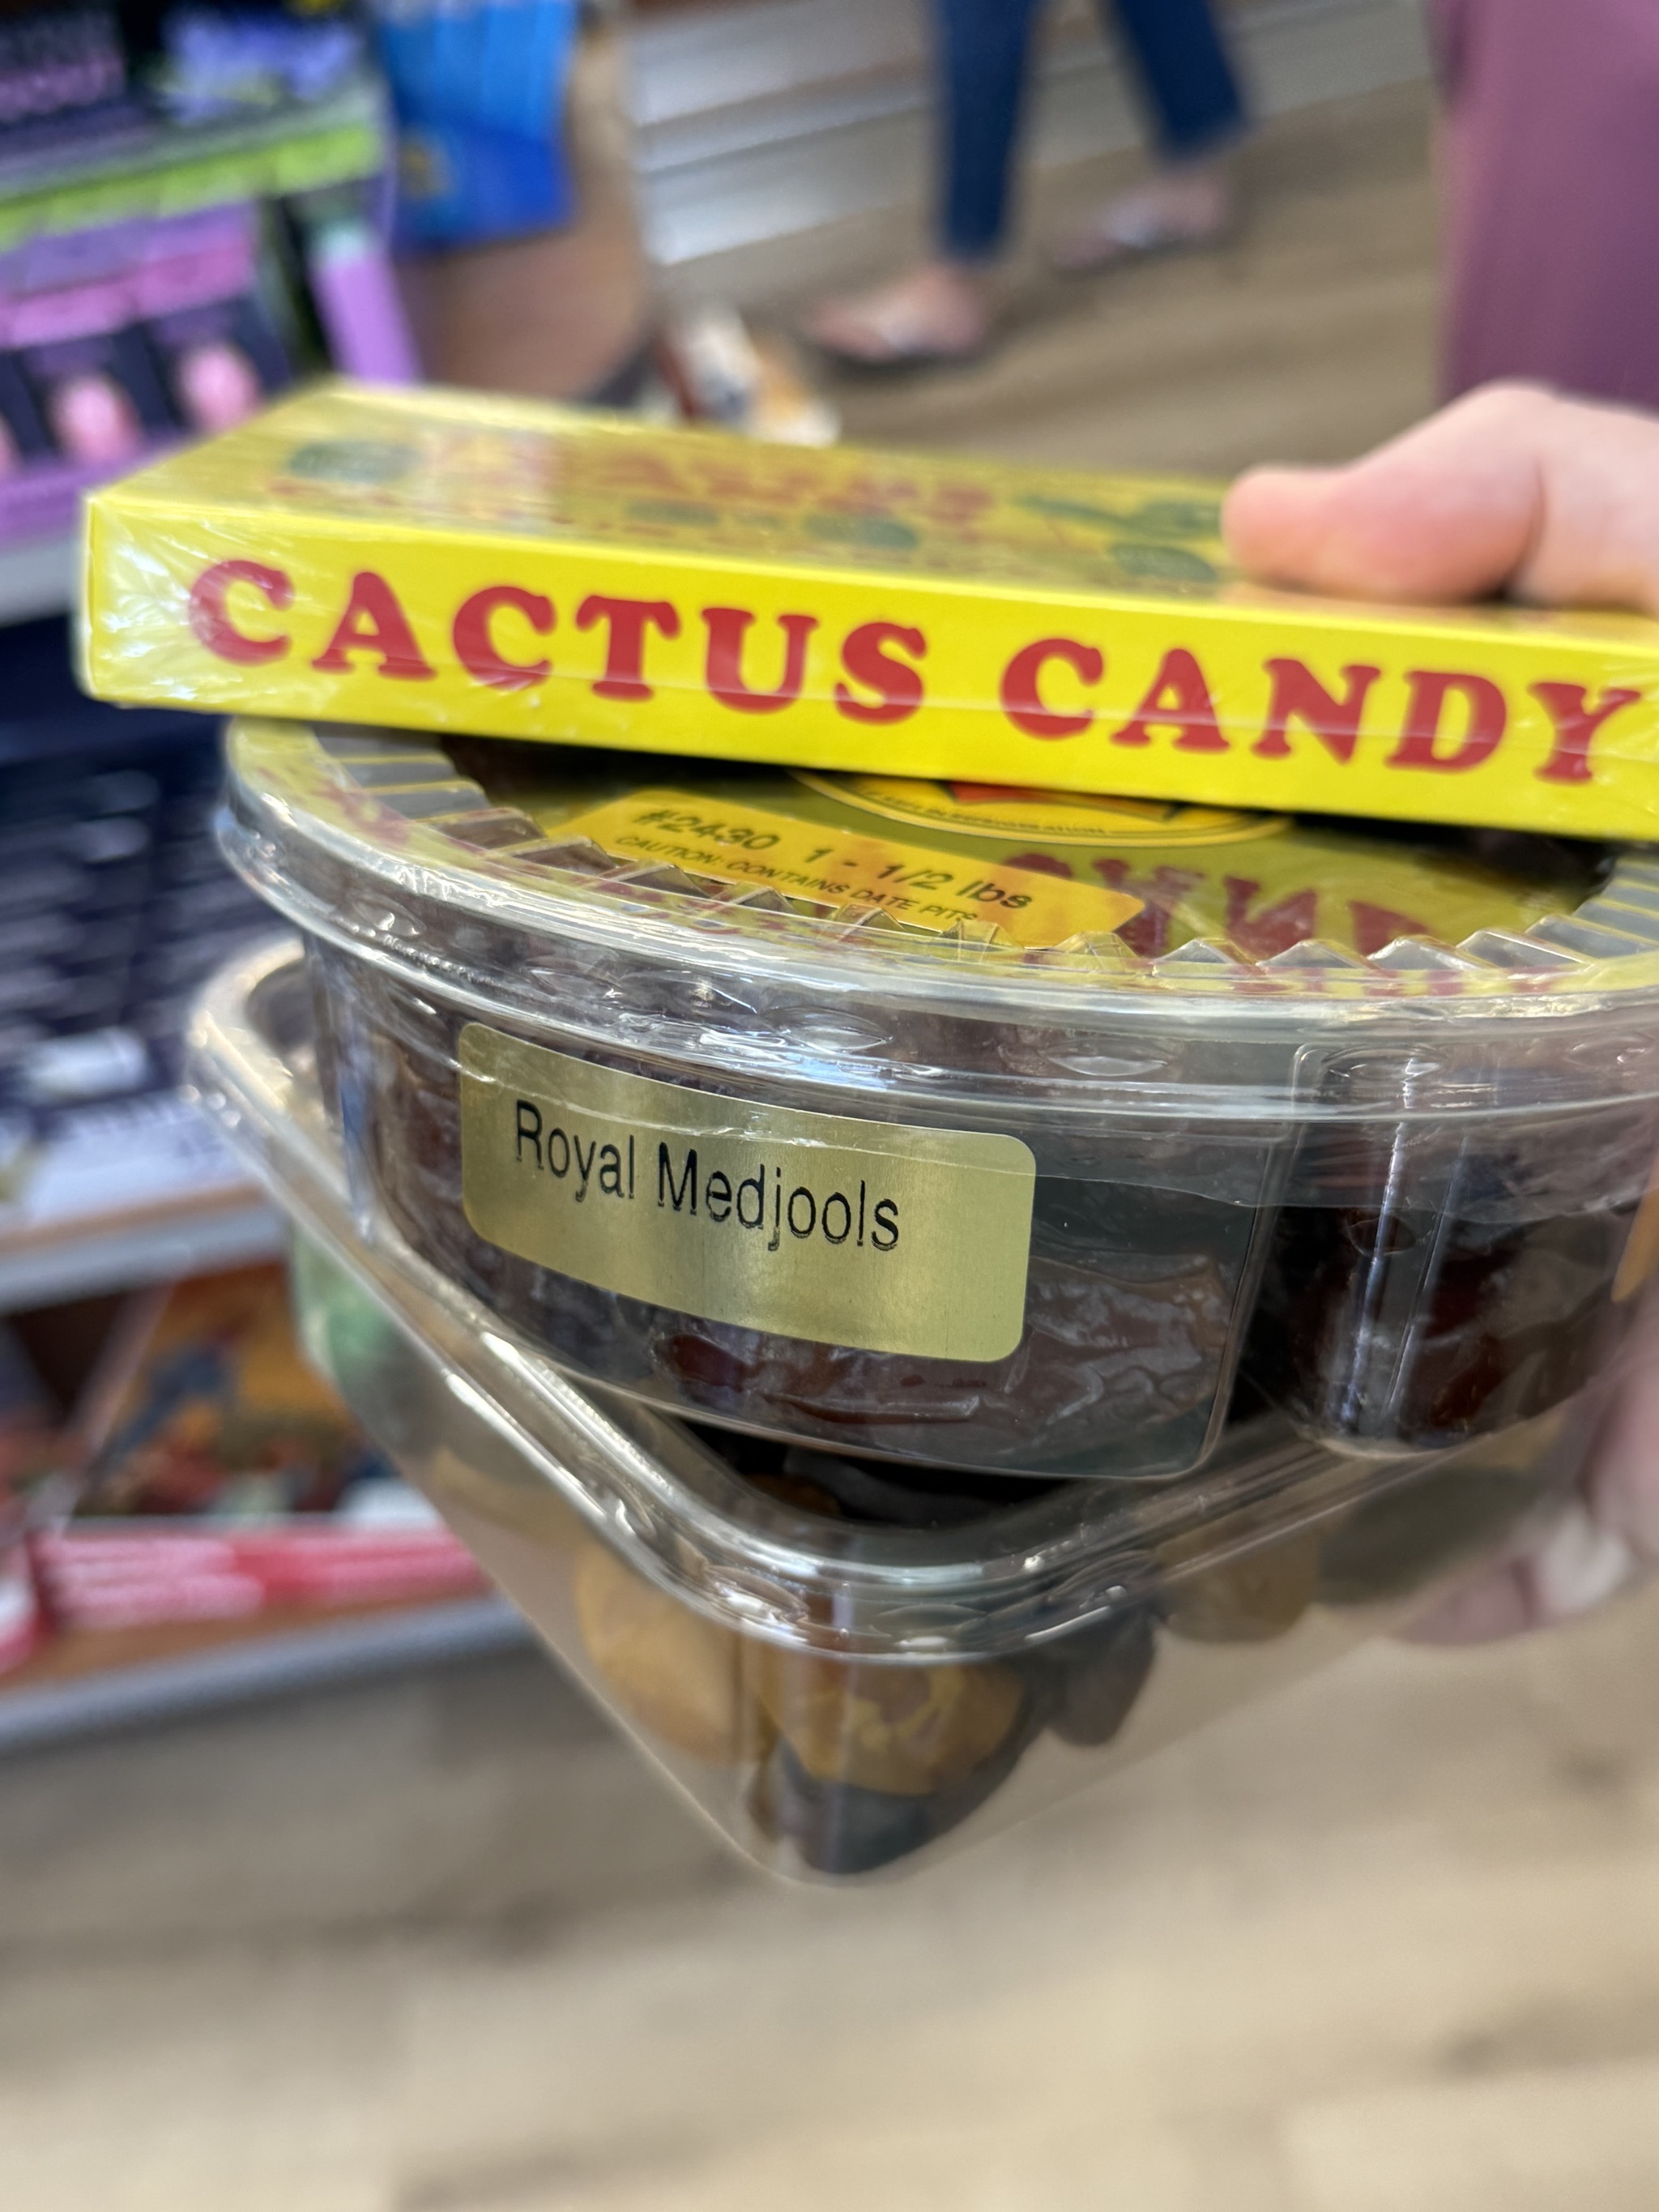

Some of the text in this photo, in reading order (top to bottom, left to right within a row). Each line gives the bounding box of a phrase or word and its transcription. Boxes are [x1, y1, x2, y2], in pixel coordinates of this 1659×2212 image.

[187, 559, 1642, 786] CACTUS CANDY
[633, 809, 781, 850] #2430
[876, 863, 954, 890] 1/2
[955, 879, 1033, 909] lbs
[727, 860, 851, 894] CONTAINS
[849, 888, 919, 911] DATE
[515, 1099, 900, 1252] Royal Medjools
